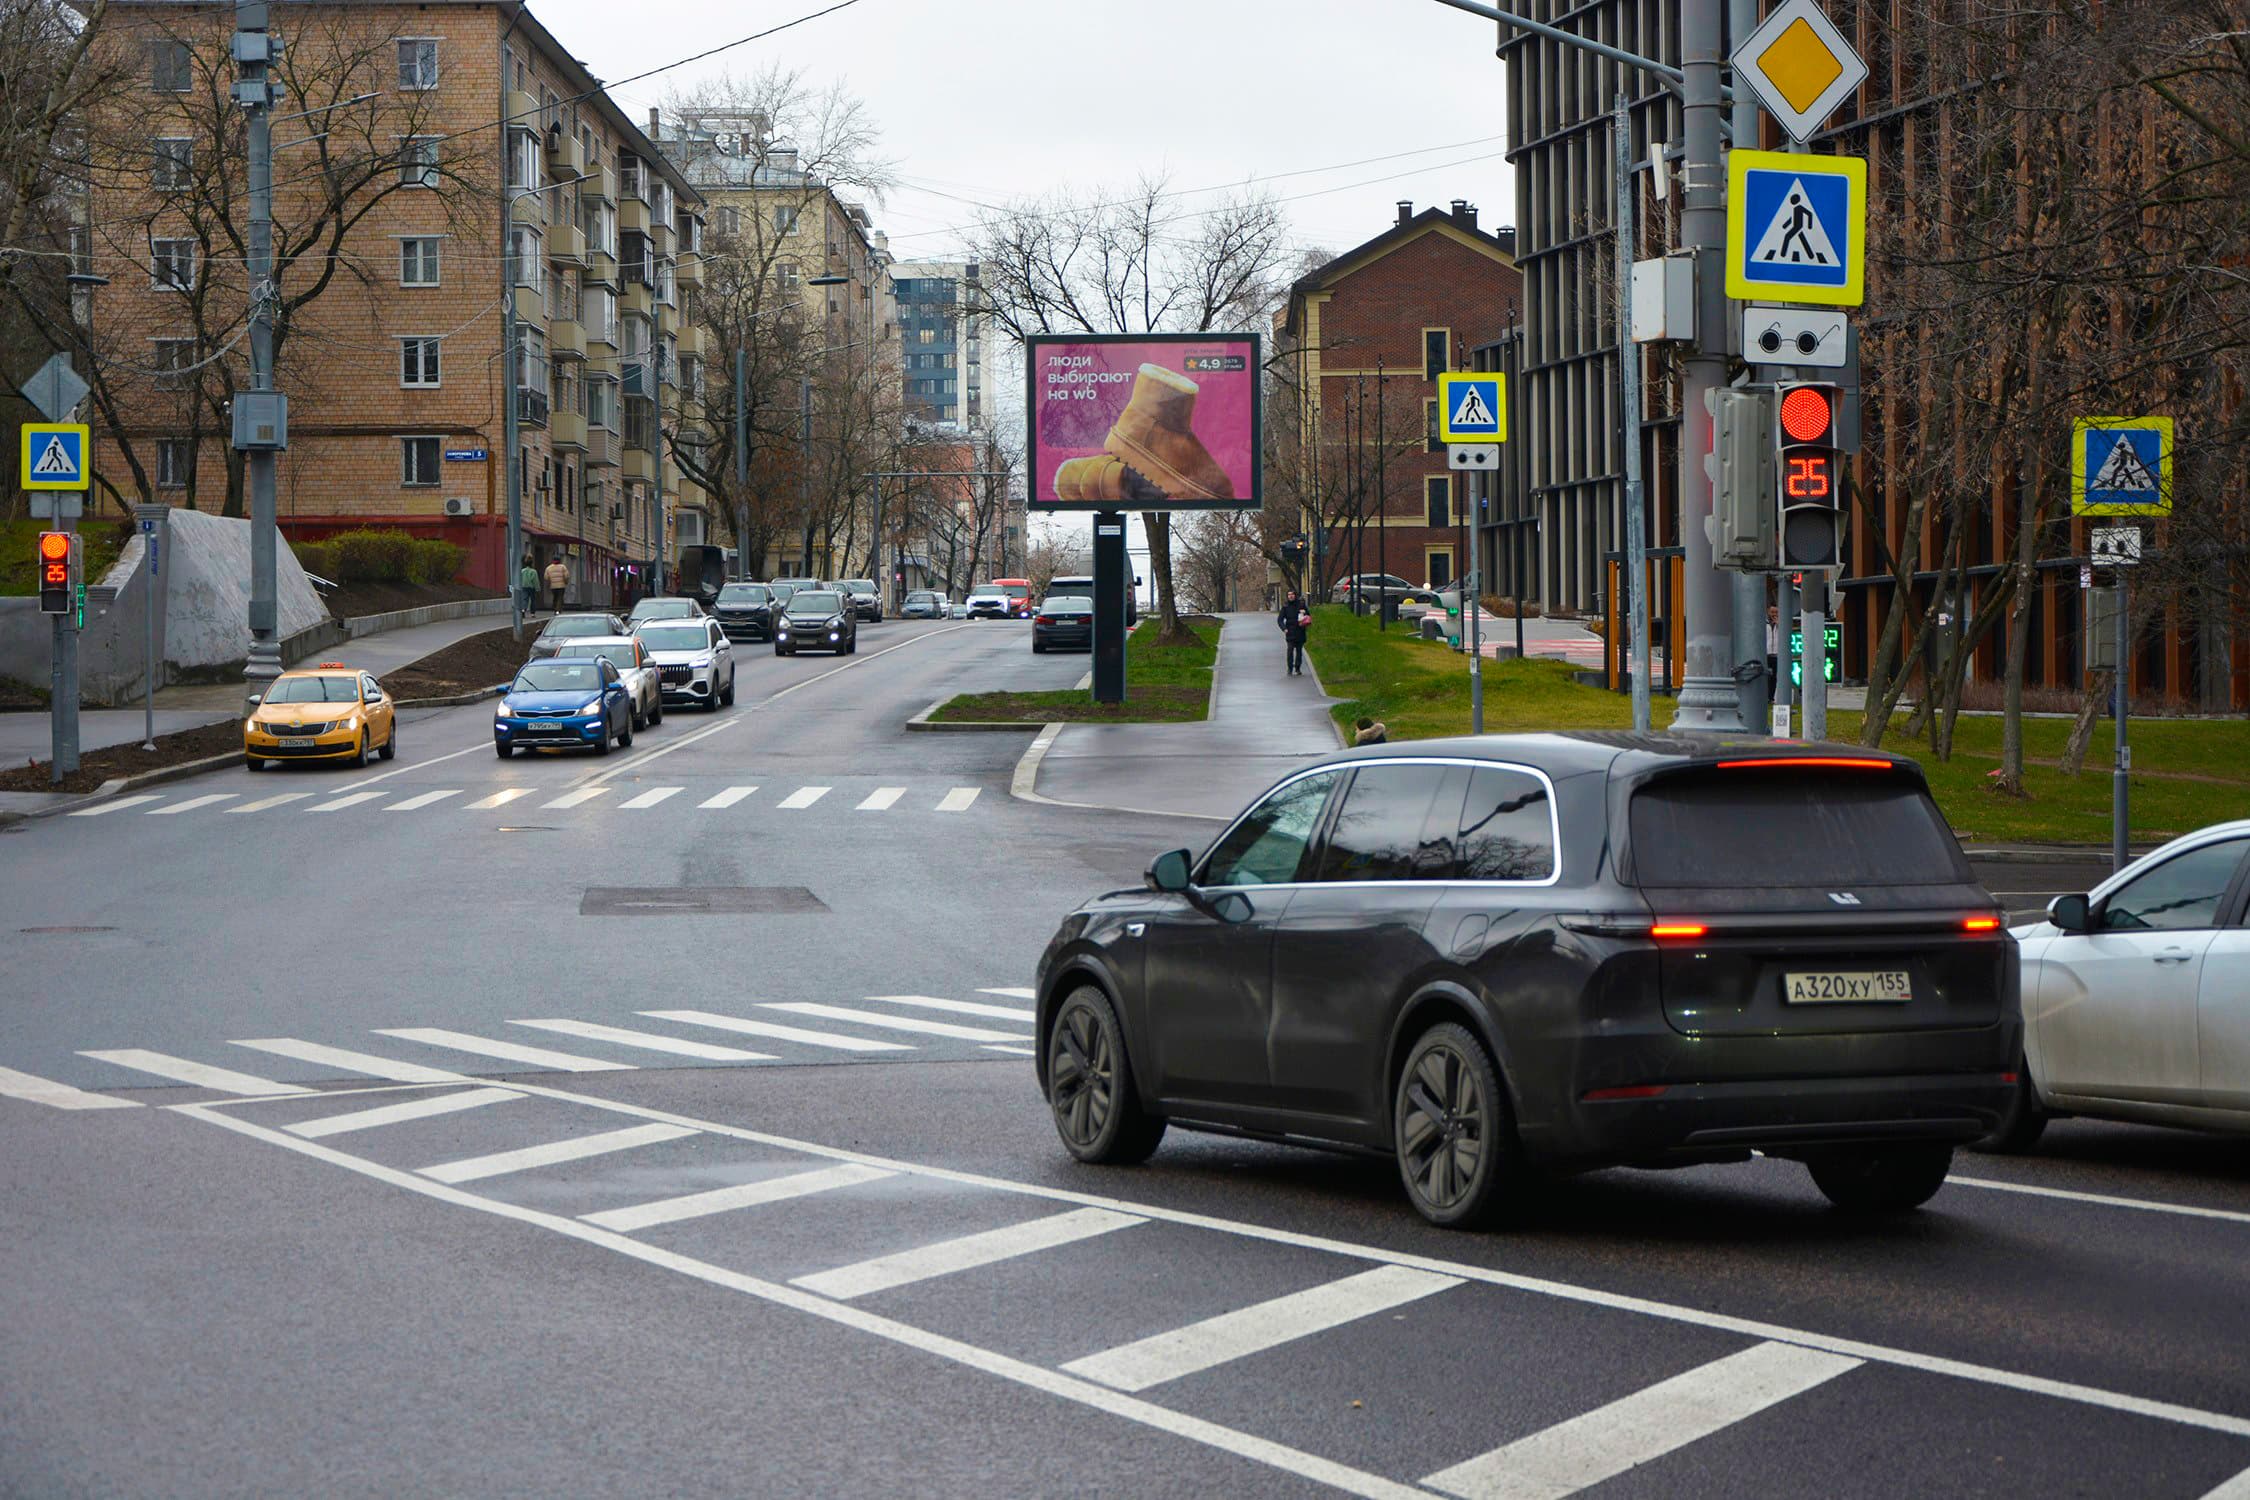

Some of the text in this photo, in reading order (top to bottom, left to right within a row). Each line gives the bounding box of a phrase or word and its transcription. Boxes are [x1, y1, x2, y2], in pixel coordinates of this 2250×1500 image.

[1048, 356, 1091, 368] люди
[1199, 359, 1221, 370] 4,9
[1048, 369, 1132, 386] выбирают
[1048, 386, 1097, 400] на wb
[1788, 458, 1828, 496] 25
[47, 564, 66, 581] 25
[1876, 973, 1905, 990] 155
